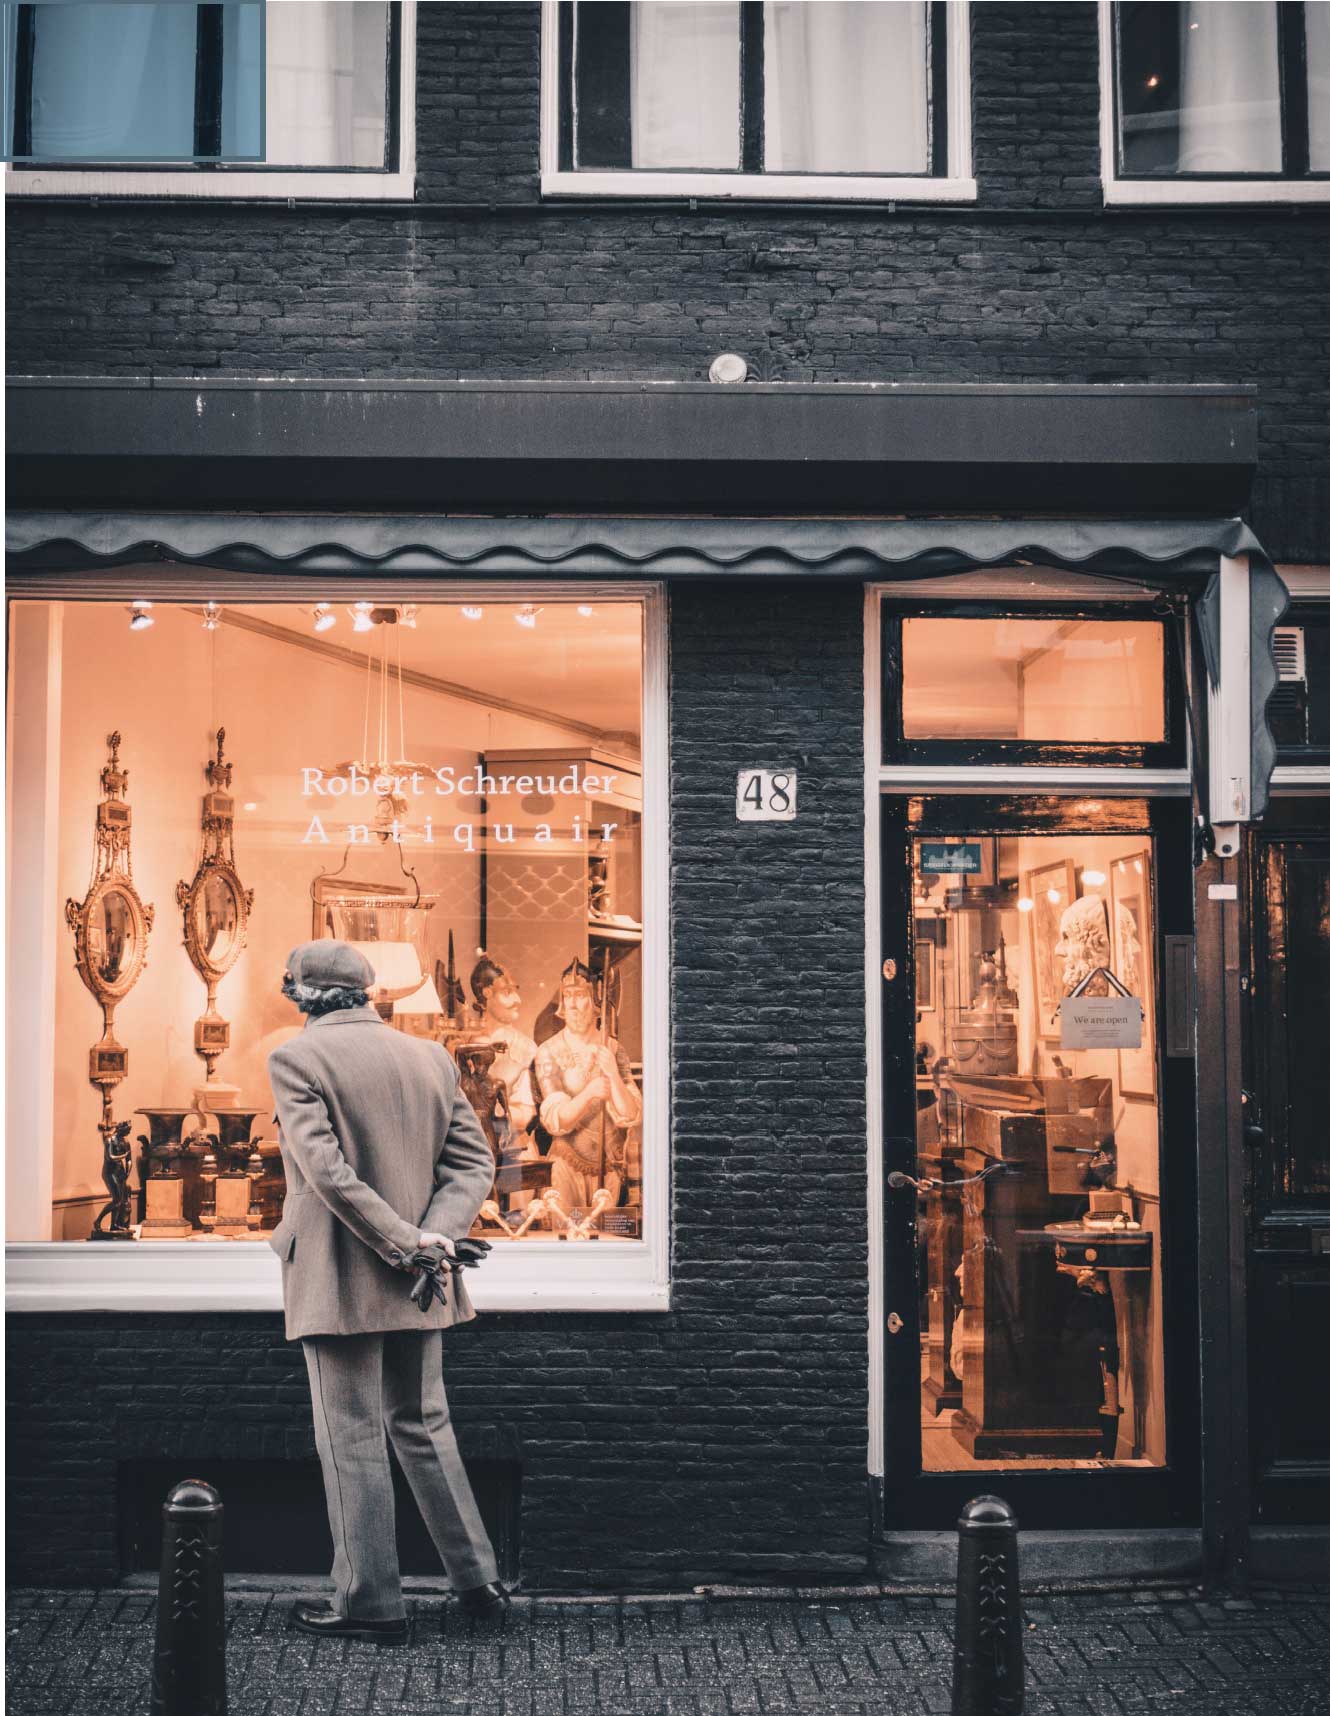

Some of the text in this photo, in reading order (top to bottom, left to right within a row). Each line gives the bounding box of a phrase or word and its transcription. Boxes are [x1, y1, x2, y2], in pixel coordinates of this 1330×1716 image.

[302, 765, 618, 796] Robert Schreuder
[743, 774, 790, 812] 48
[302, 815, 618, 852] Antiquair
[1073, 1016, 1128, 1026] We are open
